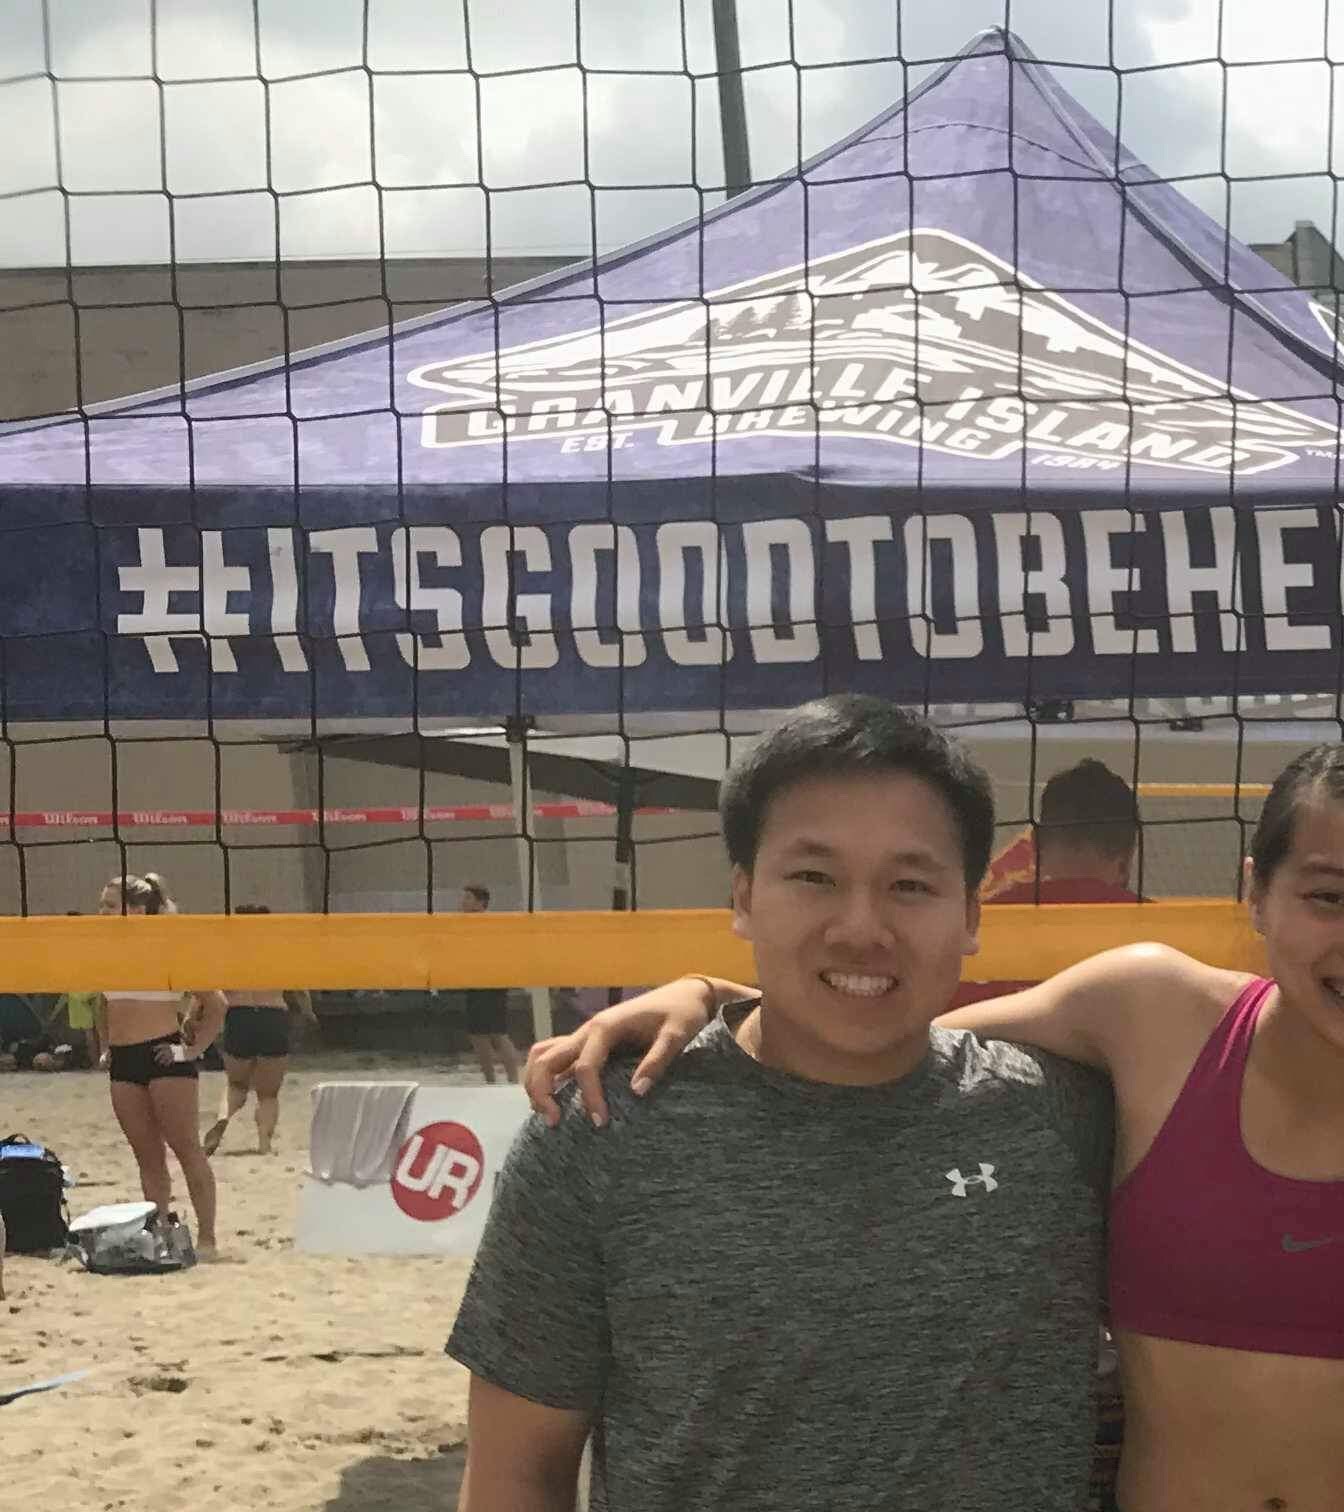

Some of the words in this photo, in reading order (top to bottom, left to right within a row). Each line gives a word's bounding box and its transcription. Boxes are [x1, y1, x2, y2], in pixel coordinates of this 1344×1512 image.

[466, 362, 933, 437] GRANVILLE
[944, 386, 1251, 469] ISLAND
[693, 400, 991, 451] BREWING
[396, 1134, 481, 1210] UR
